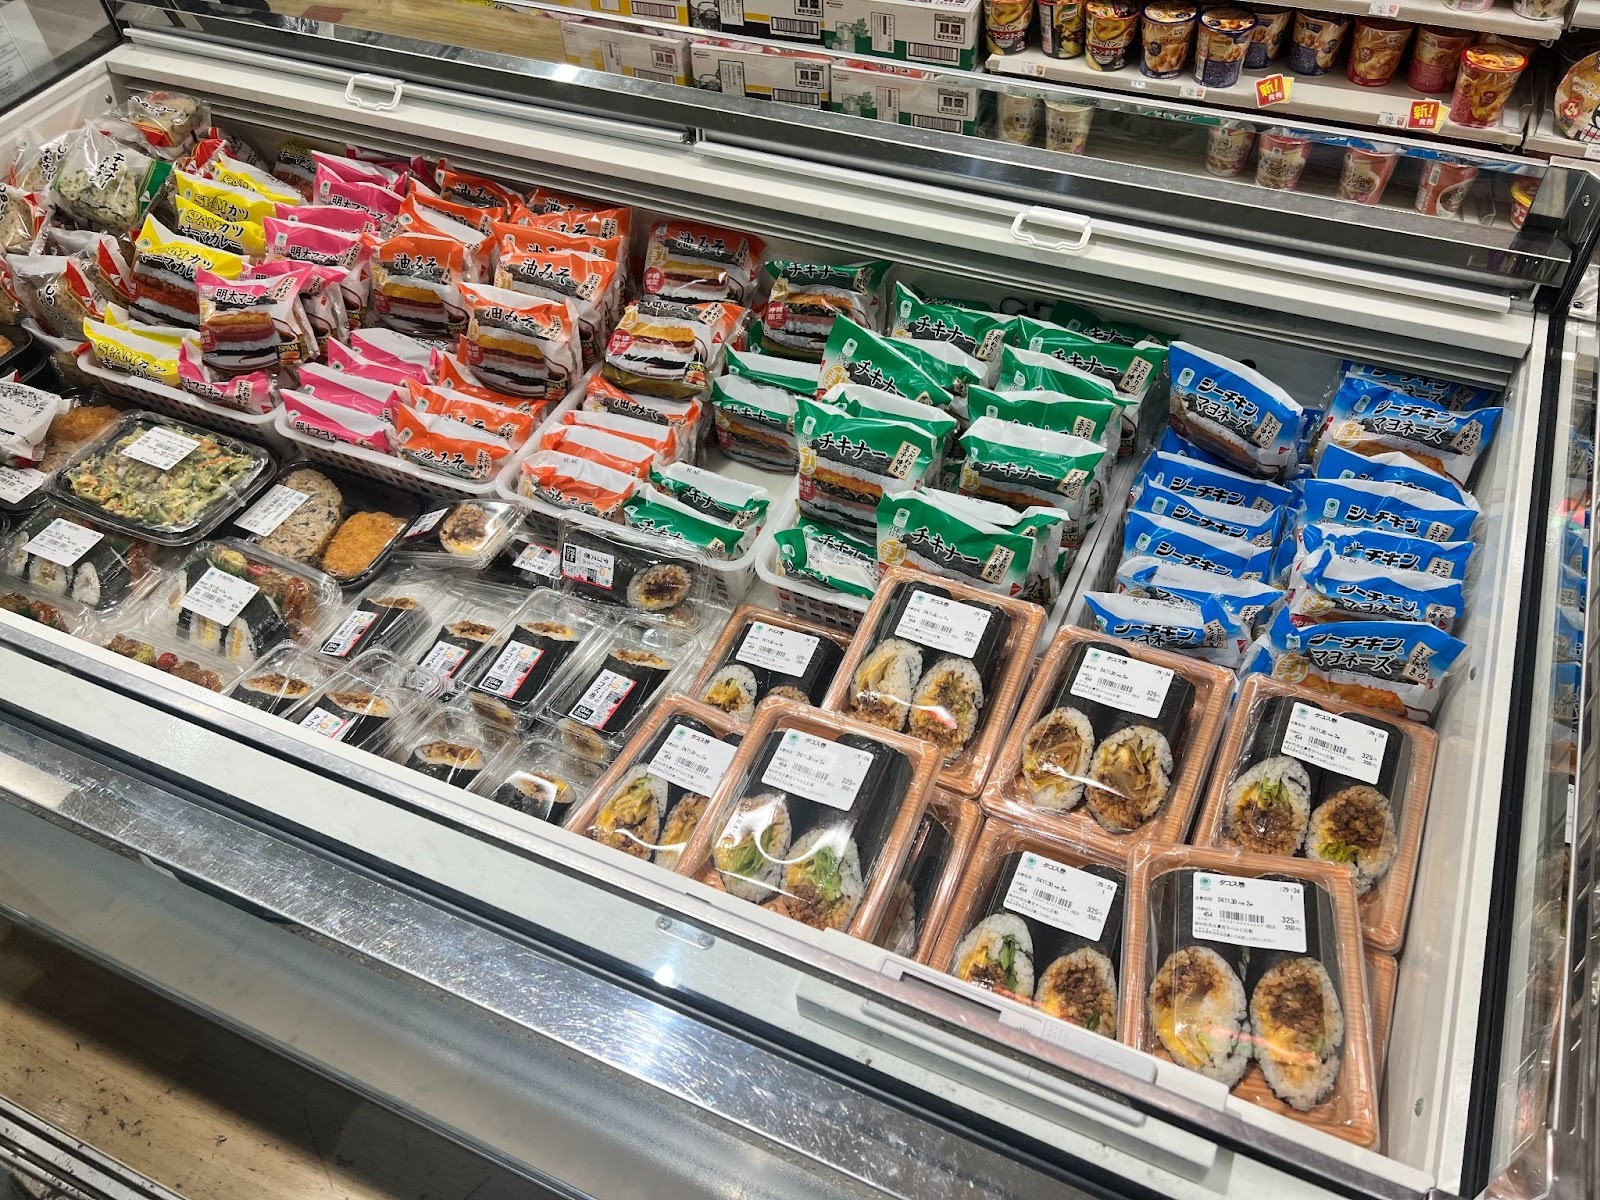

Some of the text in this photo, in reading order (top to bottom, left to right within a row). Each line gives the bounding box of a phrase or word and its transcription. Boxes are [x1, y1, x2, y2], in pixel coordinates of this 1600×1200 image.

[677, 231, 725, 255] 油みそ
[394, 252, 437, 274] 油みそ
[520, 257, 570, 285] 油みそ
[788, 262, 850, 280] チキナー
[485, 306, 535, 331] 油みそ
[915, 315, 977, 345] チキナー
[278, 344, 298, 352] SPAM
[855, 359, 907, 399] チキナー
[1197, 377, 1258, 418] シーチキン
[1195, 395, 1251, 434] マヨネーズ
[1373, 400, 1454, 425] シーチキン
[1372, 416, 1449, 445] マヨネーズ
[818, 431, 887, 459] チキナー
[415, 448, 466, 471] 油みそ
[982, 462, 1055, 480] チキナー
[1169, 476, 1244, 506] シーチキン
[1345, 504, 1420, 534] シーチキン
[911, 525, 980, 565] チキナー
[1155, 541, 1233, 577] シーチキン
[1337, 585, 1418, 613] シーチキン
[1114, 622, 1197, 640] シーチキン
[1308, 633, 1404, 653] シーチキン
[1311, 648, 1394, 675] マヨネーズ
[1042, 862, 1066, 874] タコス巻
[1219, 879, 1246, 888] タコス巻
